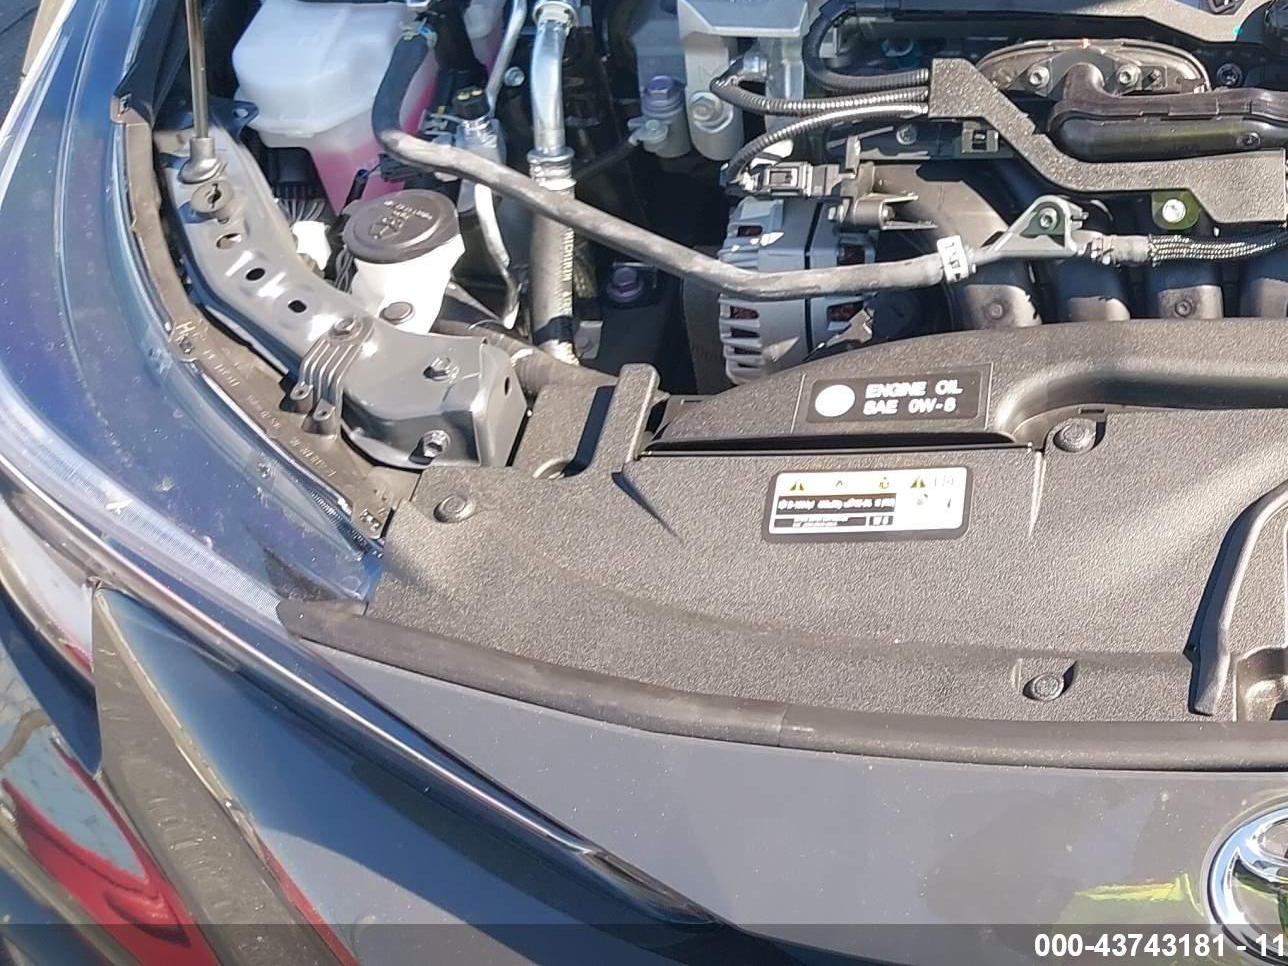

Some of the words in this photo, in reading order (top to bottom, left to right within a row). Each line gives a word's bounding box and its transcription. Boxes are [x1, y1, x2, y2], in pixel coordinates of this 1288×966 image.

[864, 381, 928, 399] ENGINE
[935, 379, 963, 396] OIL
[862, 399, 899, 415] SAE
